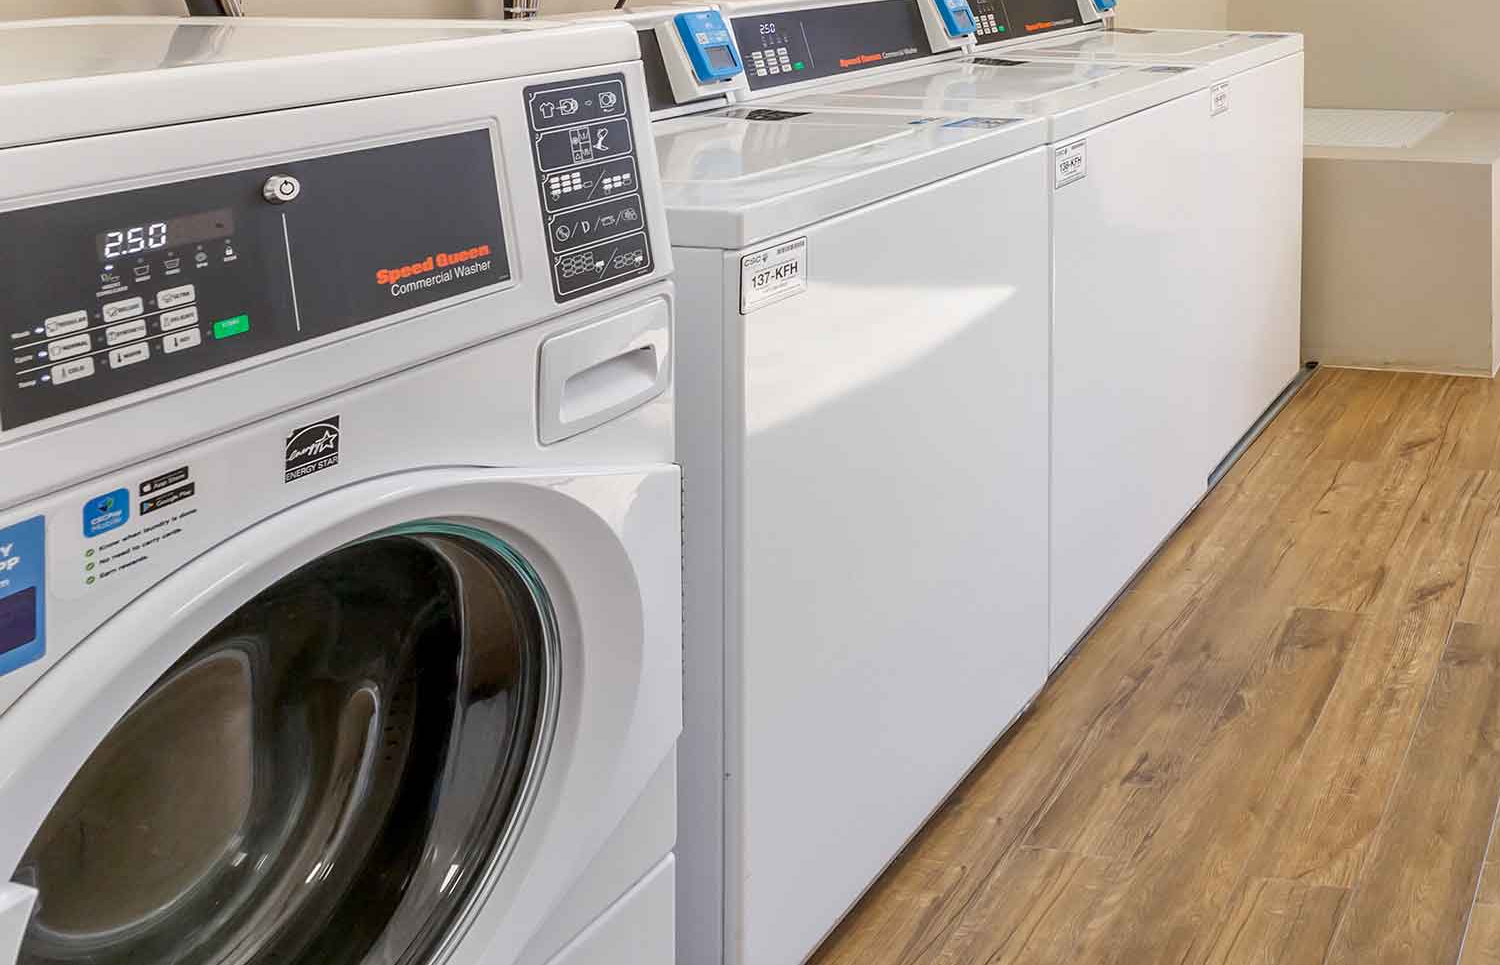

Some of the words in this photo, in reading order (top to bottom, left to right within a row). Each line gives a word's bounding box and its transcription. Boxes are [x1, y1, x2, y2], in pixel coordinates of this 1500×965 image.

[104, 223, 166, 258] 2.50
[376, 256, 433, 284] Speed
[435, 245, 491, 268] Queen
[391, 270, 453, 296] Commercial
[454, 260, 491, 278] Washer
[752, 261, 798, 288] 137-KFH
[286, 463, 317, 481] ENERGY
